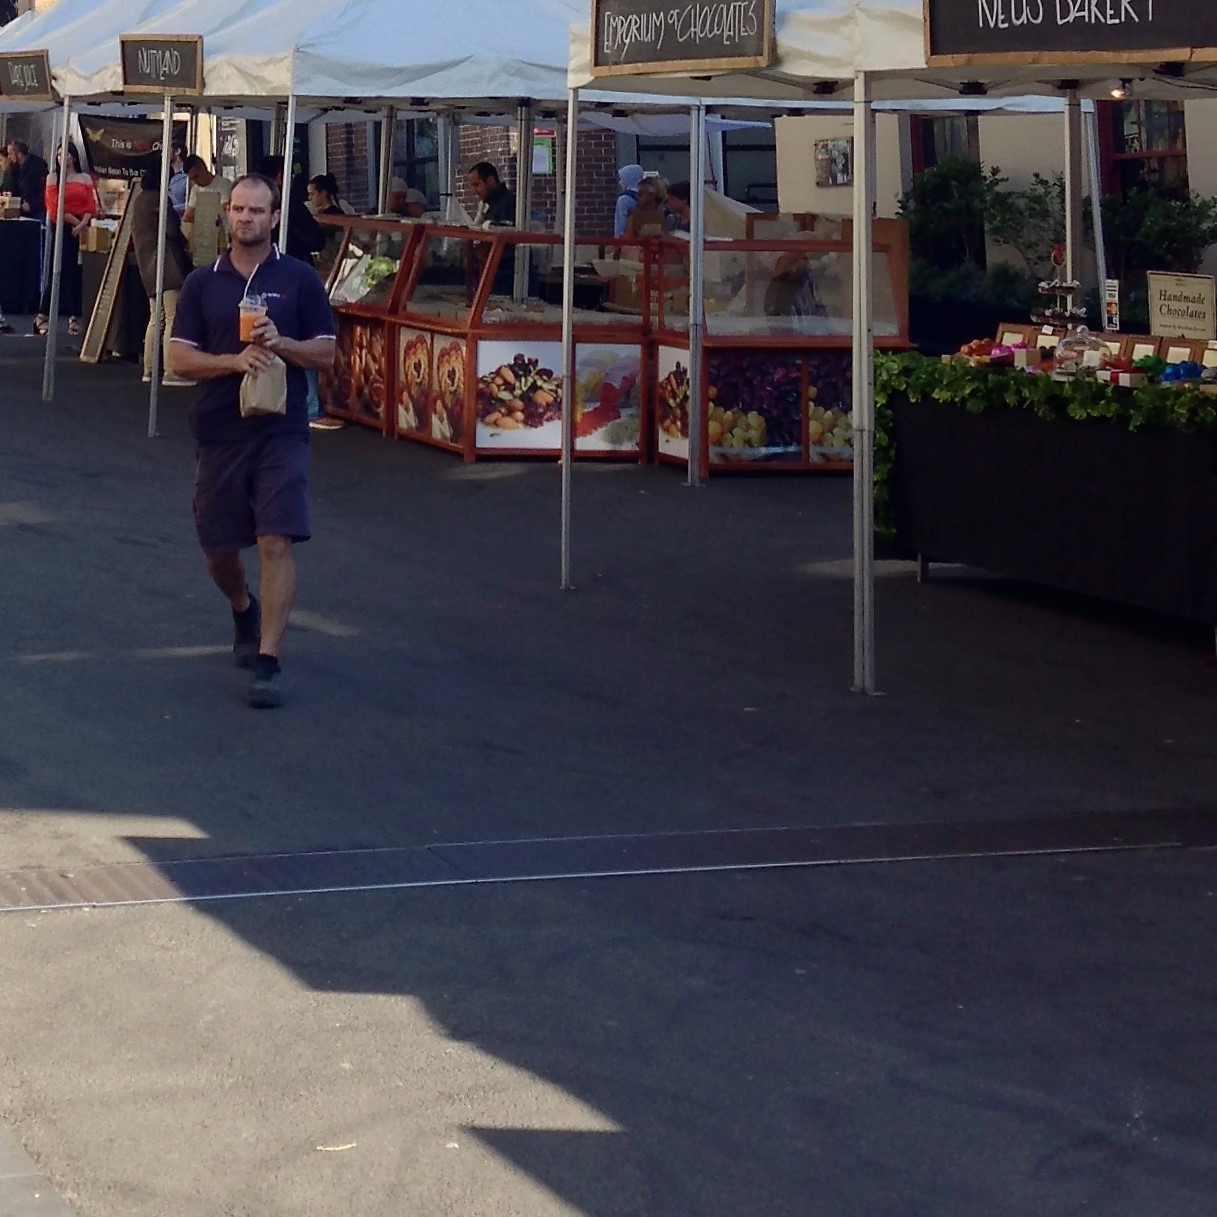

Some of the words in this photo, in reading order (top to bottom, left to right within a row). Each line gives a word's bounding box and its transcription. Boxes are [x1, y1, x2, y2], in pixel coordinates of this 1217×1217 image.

[604, 11, 665, 61] EMPORIUM
[677, 0, 757, 45] CHOCOLATES
[1159, 289, 1206, 305] Handmade
[1159, 303, 1206, 319] Chocolates
